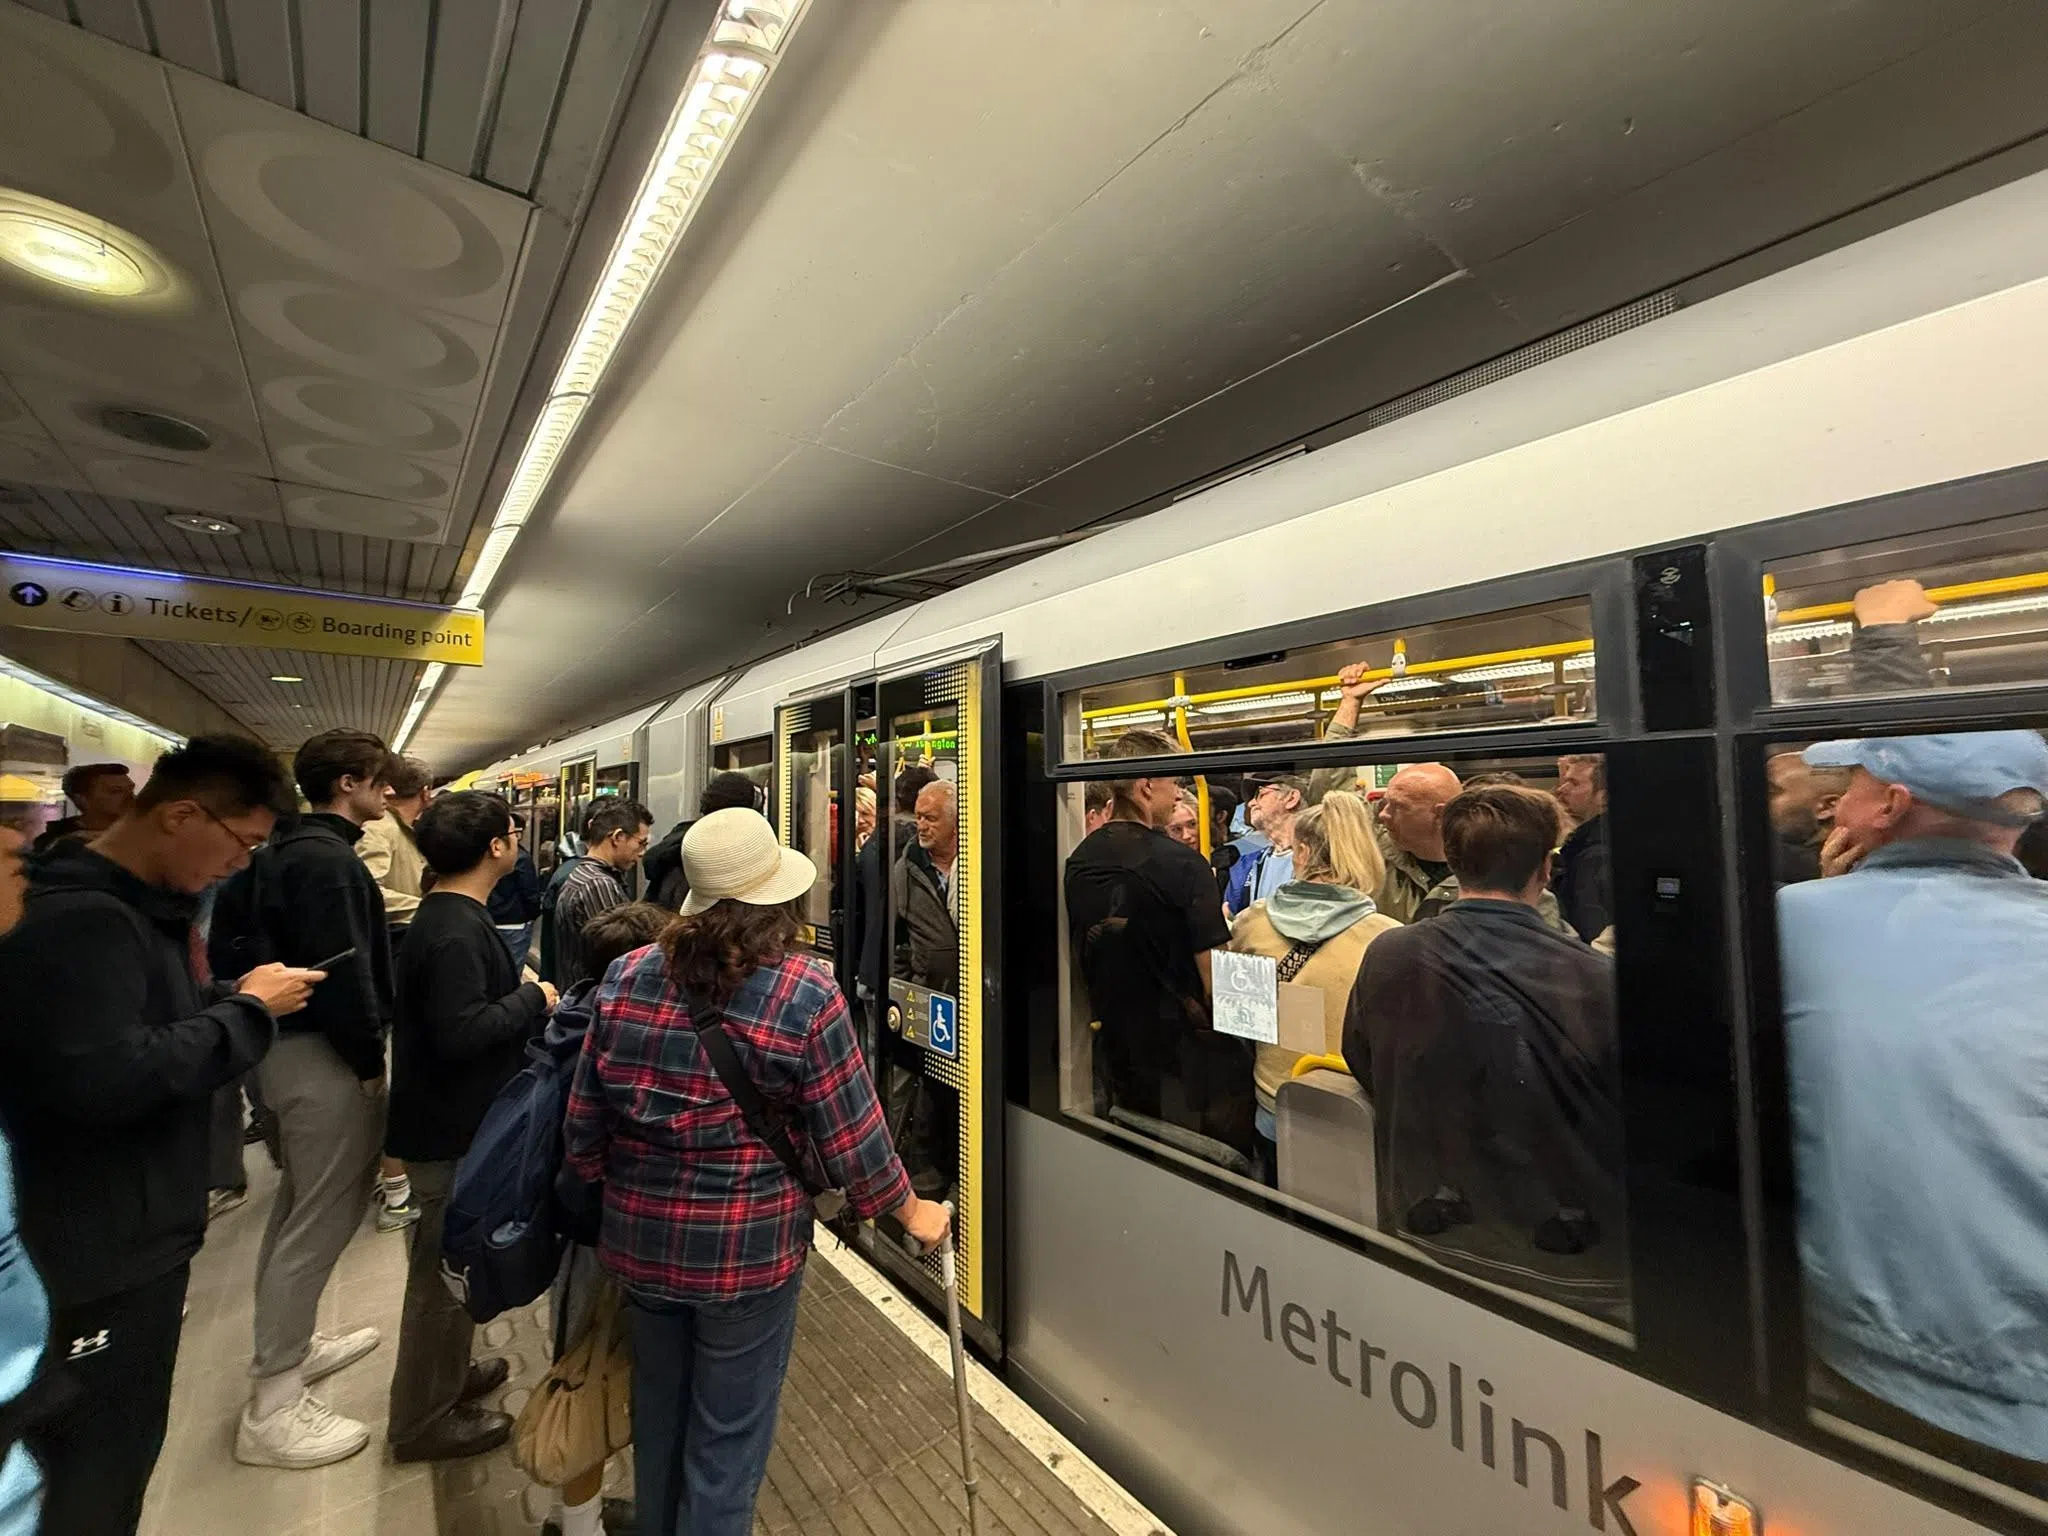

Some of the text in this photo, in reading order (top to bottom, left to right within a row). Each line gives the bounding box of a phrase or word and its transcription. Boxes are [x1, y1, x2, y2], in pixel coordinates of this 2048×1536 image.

[145, 597, 252, 628] Tickets/
[322, 616, 416, 645] Boarding
[421, 629, 472, 647] point
[1220, 1250, 1642, 1536] Metrolink
